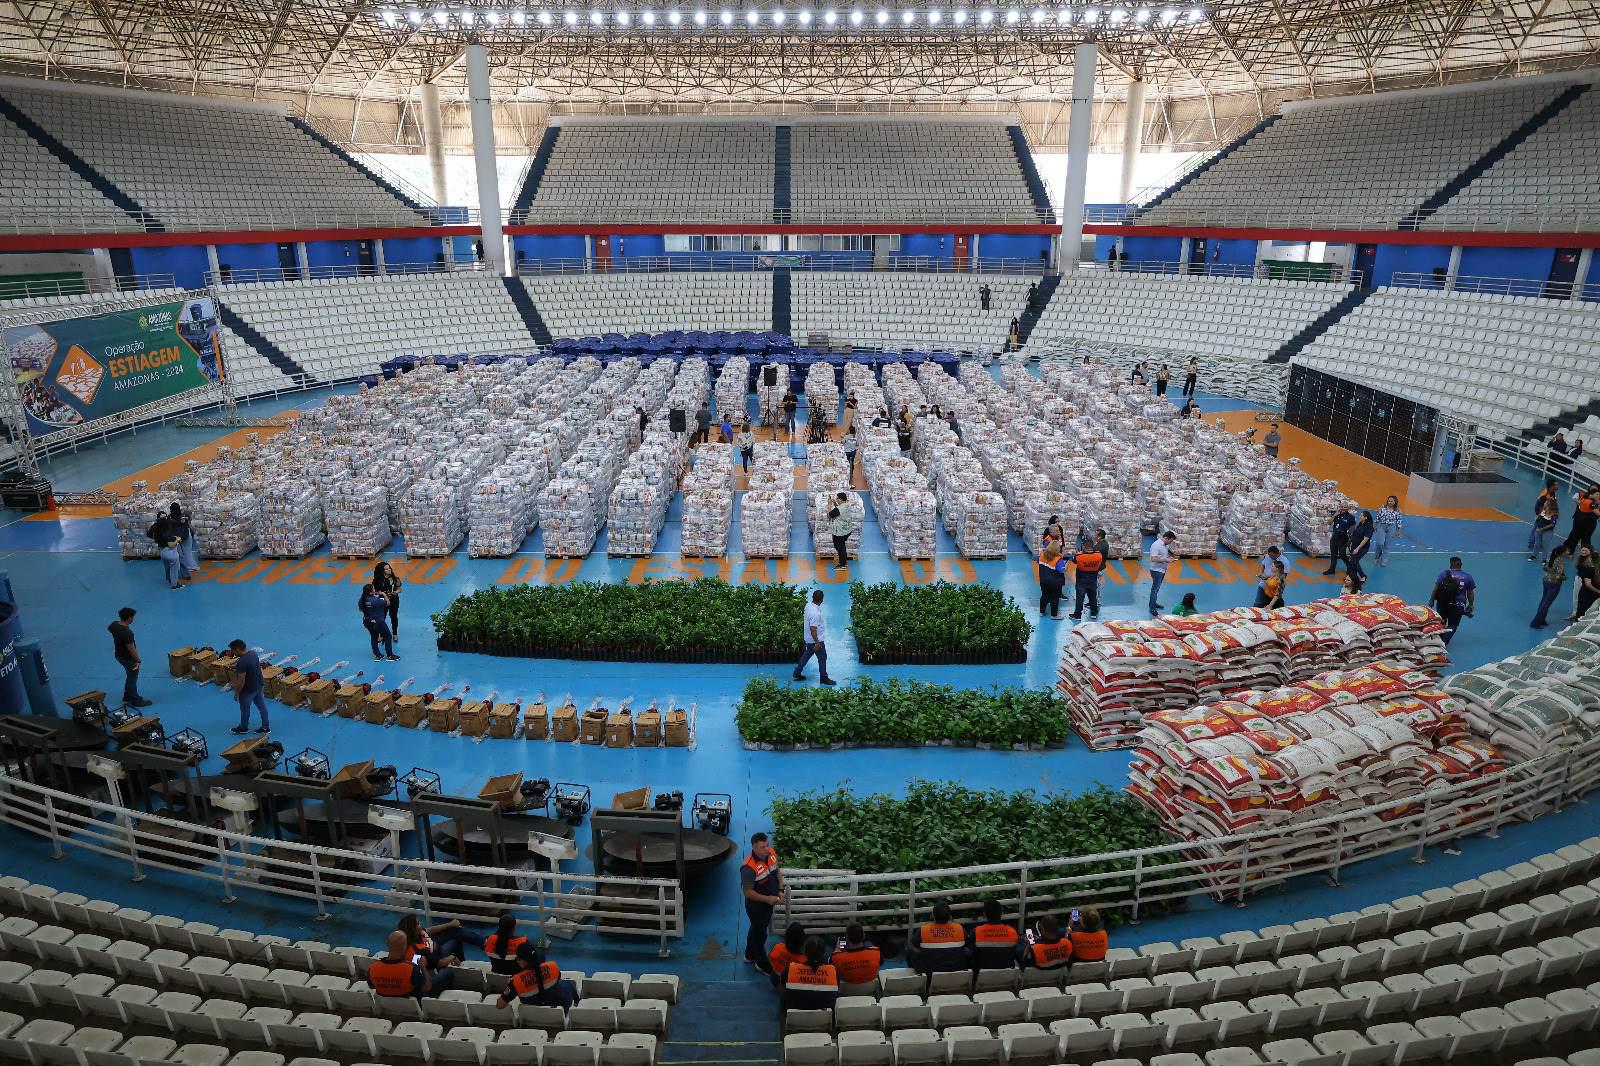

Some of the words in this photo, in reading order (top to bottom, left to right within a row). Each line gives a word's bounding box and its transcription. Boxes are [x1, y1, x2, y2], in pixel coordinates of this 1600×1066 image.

[104, 341, 145, 357] Operação
[108, 345, 181, 378] ESTIAGEM
[114, 371, 160, 391] AMAZONAS
[165, 364, 184, 377] 2024
[496, 557, 583, 584] DO
[627, 557, 849, 584] ESTADO
[900, 558, 977, 584] DO
